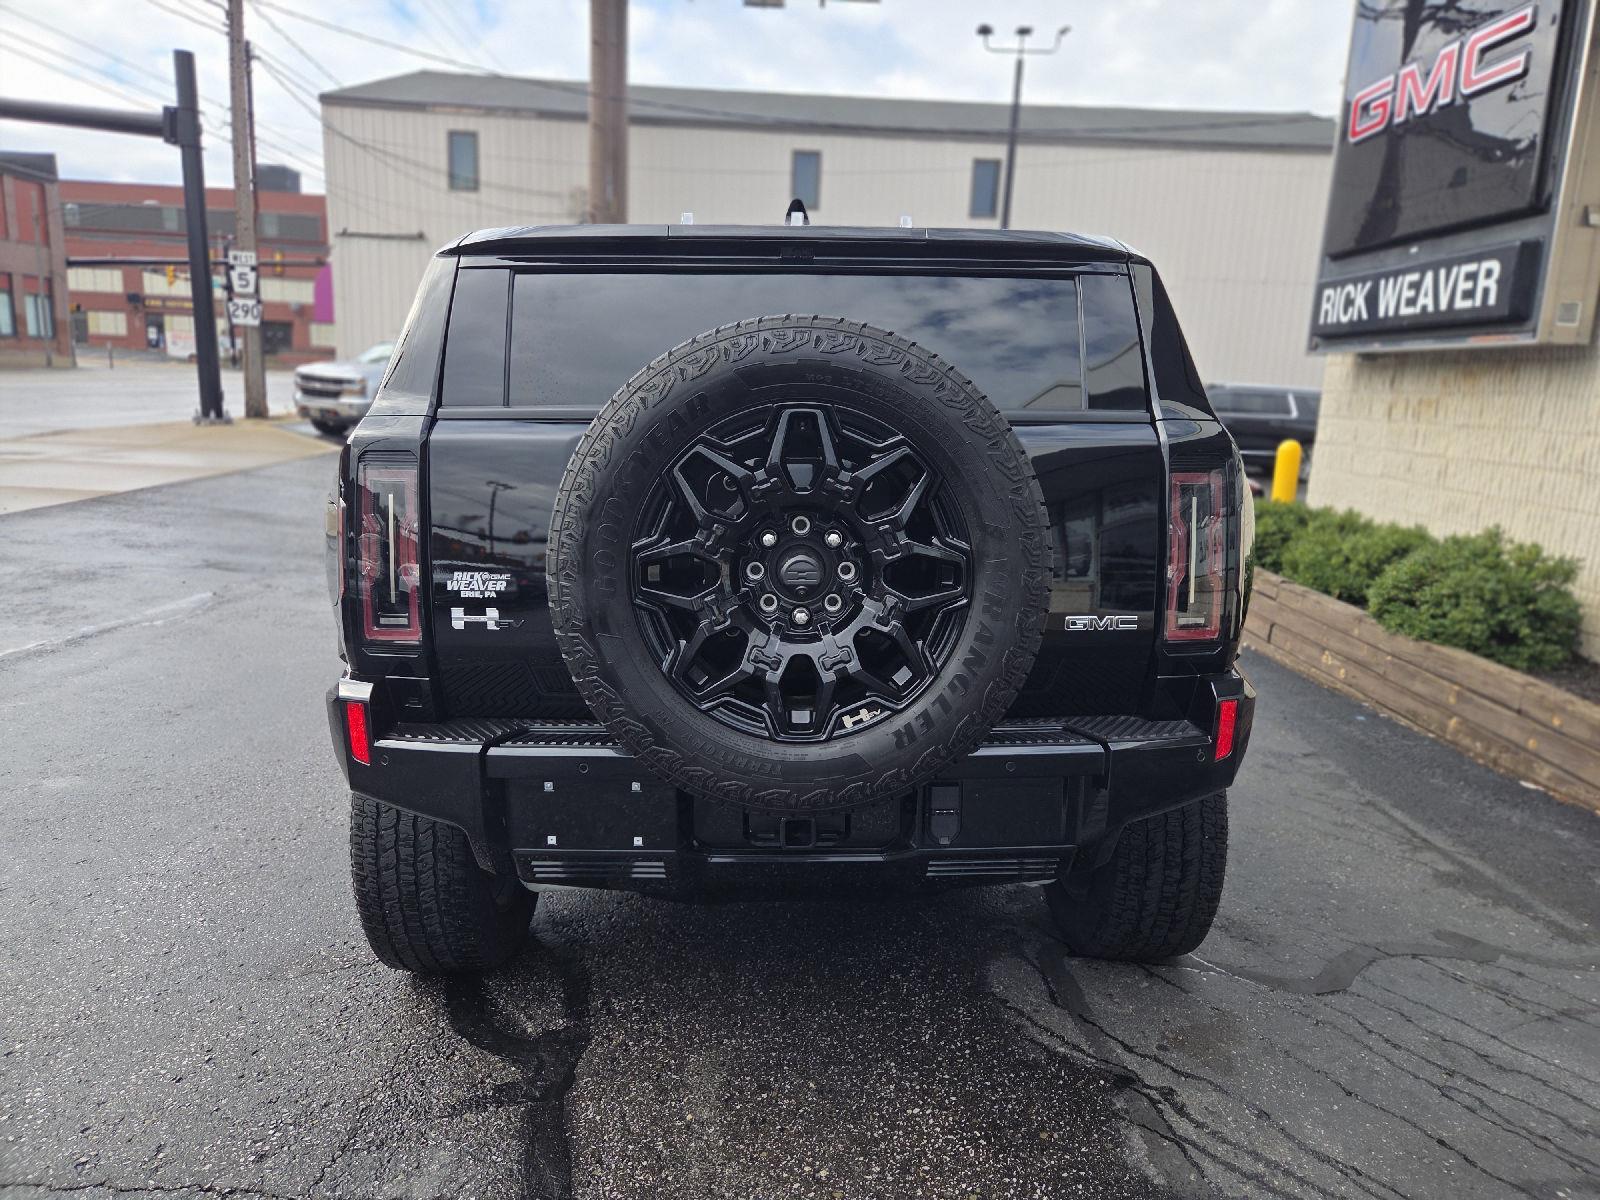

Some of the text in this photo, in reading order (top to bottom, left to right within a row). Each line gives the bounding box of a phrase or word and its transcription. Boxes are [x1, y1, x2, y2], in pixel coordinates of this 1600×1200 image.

[1348, 7, 1535, 143] GMC
[231, 253, 253, 264] WEST
[238, 272, 250, 288] 5
[1319, 259, 1502, 325] RICK WEAVER
[231, 303, 260, 319] 290
[453, 571, 483, 581] RICK
[447, 580, 507, 591] WEAVER
[485, 590, 497, 598] PA
[1064, 615, 1139, 631] GMC
[892, 557, 1009, 749] WRANGLER
